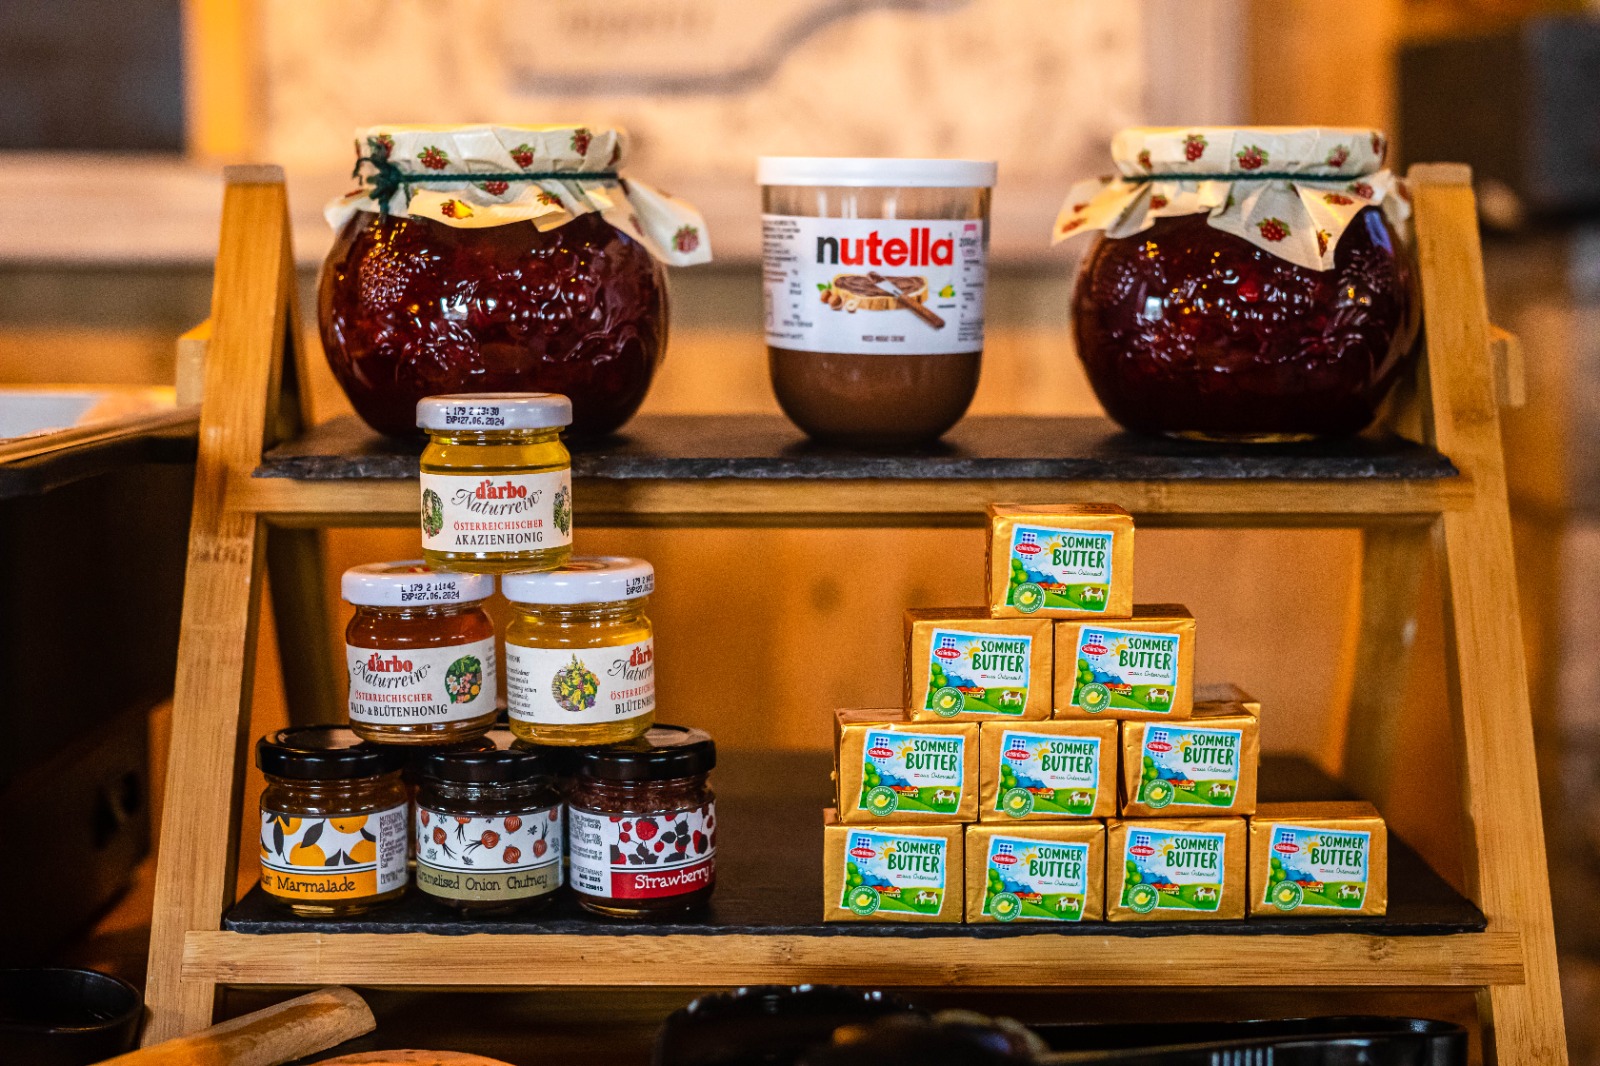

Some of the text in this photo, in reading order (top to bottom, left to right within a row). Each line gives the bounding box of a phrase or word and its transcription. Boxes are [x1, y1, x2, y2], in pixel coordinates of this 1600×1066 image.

[816, 228, 954, 267] nutella
[454, 407, 466, 415] 179
[469, 407, 474, 415] 2
[446, 416, 505, 426] EXP:27.06.2024
[451, 488, 542, 516] Naturrein
[454, 519, 543, 531] ÖSTERREICHISCHER
[455, 532, 543, 545] AKAZIENHONIG
[1062, 536, 1107, 550] SOMMER
[1052, 549, 1105, 569] BUTTER
[401, 582, 456, 592] L 179 2 11:42
[401, 590, 460, 601] EXP:27.06.2024
[981, 641, 1025, 654] SOMMER
[1128, 638, 1173, 652] SOMMER
[972, 653, 1024, 672] BUTTER
[1119, 650, 1172, 670] BUTTER
[353, 659, 431, 689] Naturrein
[355, 691, 433, 703] ÖSTERREICHISCHER
[374, 703, 448, 717] BLÜTENHONIG
[914, 740, 959, 754] SOMMER
[1192, 734, 1236, 748] SOMMER
[1050, 742, 1094, 756] SOMMER
[905, 753, 957, 771] BUTTER
[1183, 747, 1234, 766] BUTTER
[1042, 755, 1092, 773] BUTTER
[896, 841, 941, 855] SOMMER
[1174, 838, 1219, 851] SOMMER
[1320, 836, 1364, 849] SOMMER
[1038, 848, 1082, 861] SOMMER
[1166, 851, 1218, 869] BUTTER
[1311, 848, 1362, 867] BUTTER
[887, 854, 940, 873] BUTTER
[1029, 859, 1081, 879] BUTTER
[277, 876, 356, 893] Marmalade
[465, 877, 501, 891] Onion
[506, 874, 548, 889] Chutney
[634, 867, 709, 889] Strawberry
